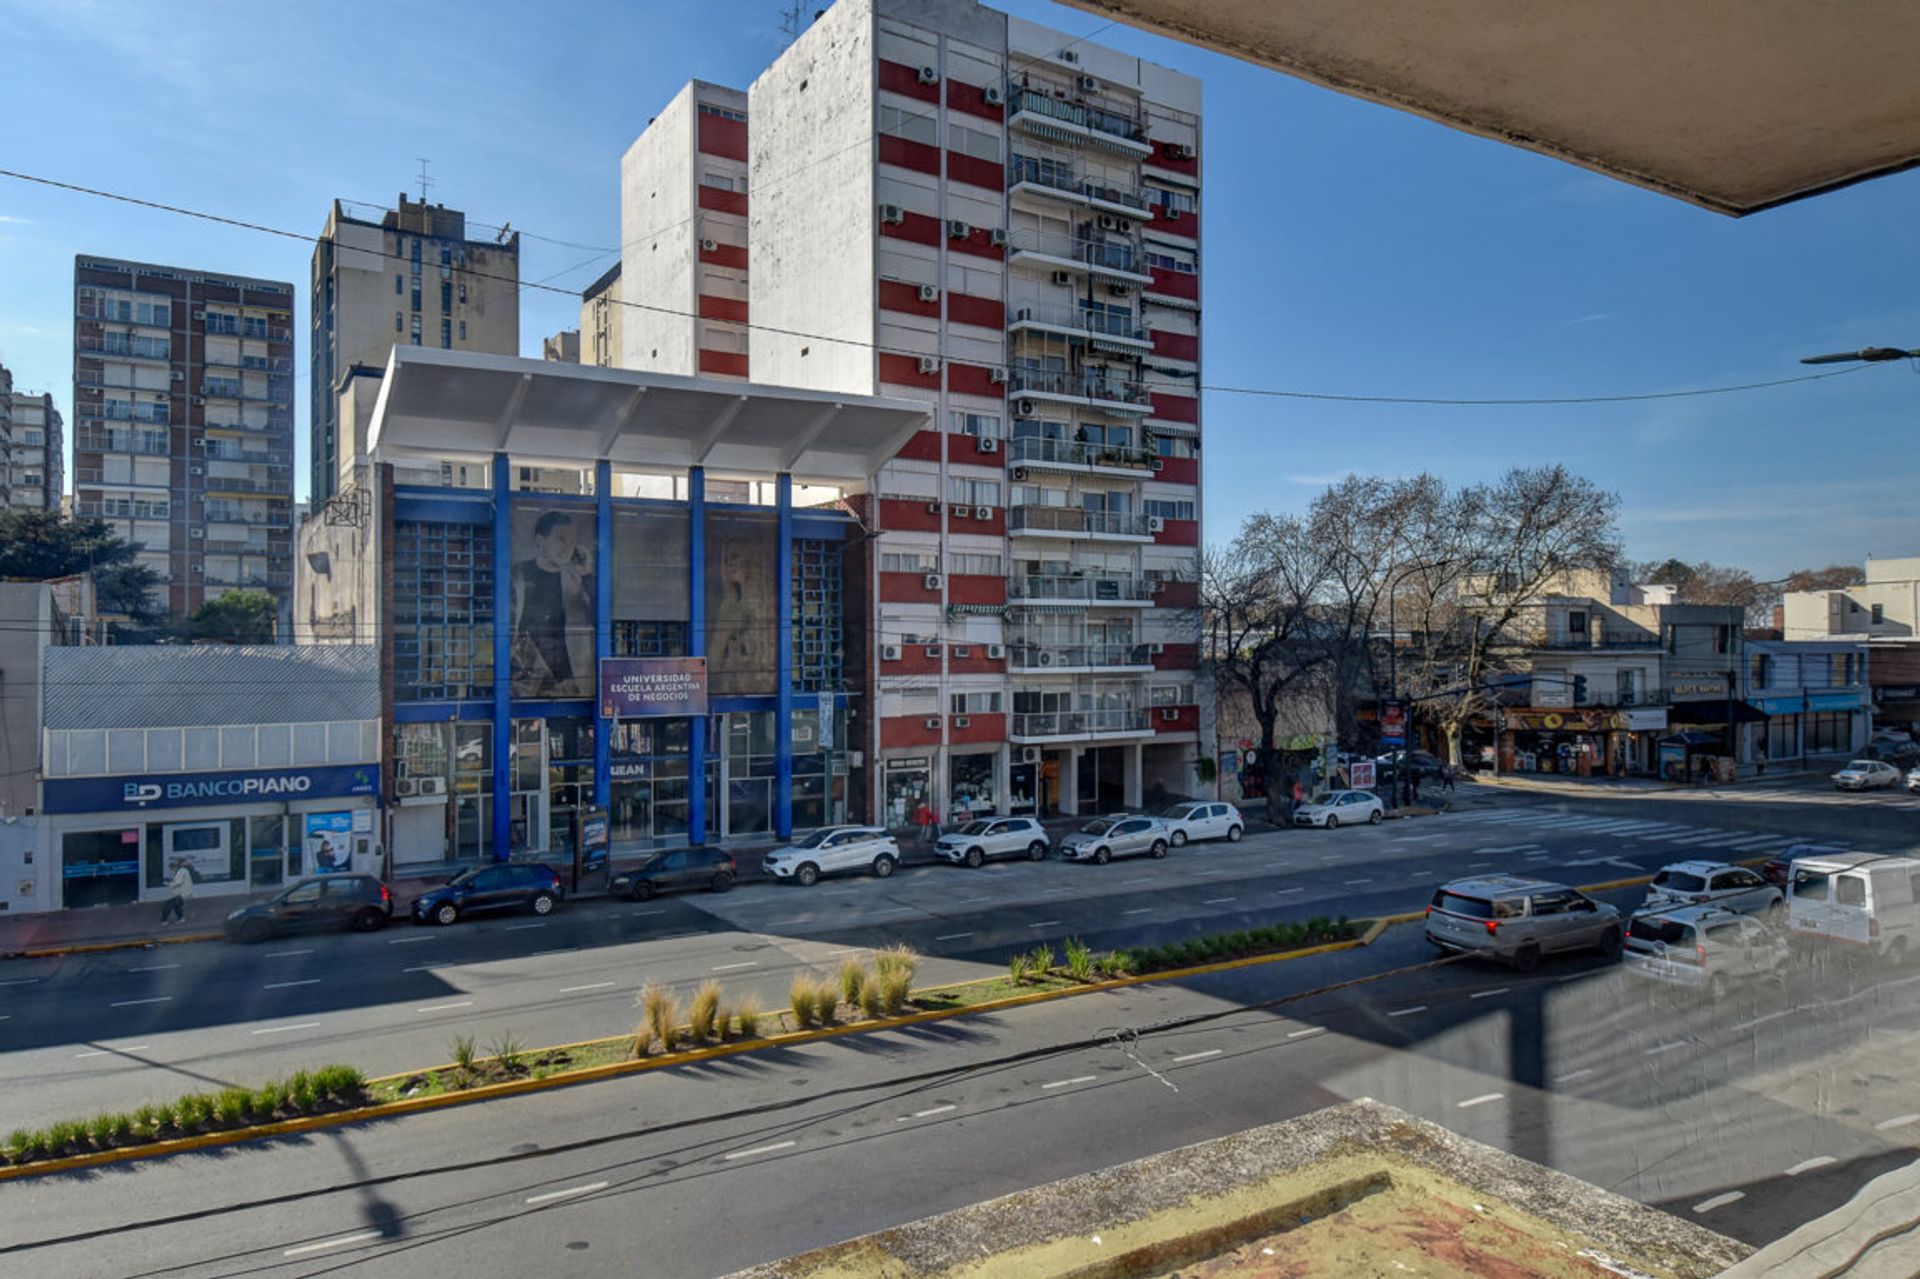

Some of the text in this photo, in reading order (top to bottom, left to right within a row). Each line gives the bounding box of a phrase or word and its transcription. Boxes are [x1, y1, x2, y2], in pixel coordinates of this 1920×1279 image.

[623, 674, 691, 683] UNIVERSIDAD
[611, 682, 700, 692] ESCUELA ARGENTINA
[643, 693, 688, 701] NEGOCIOS
